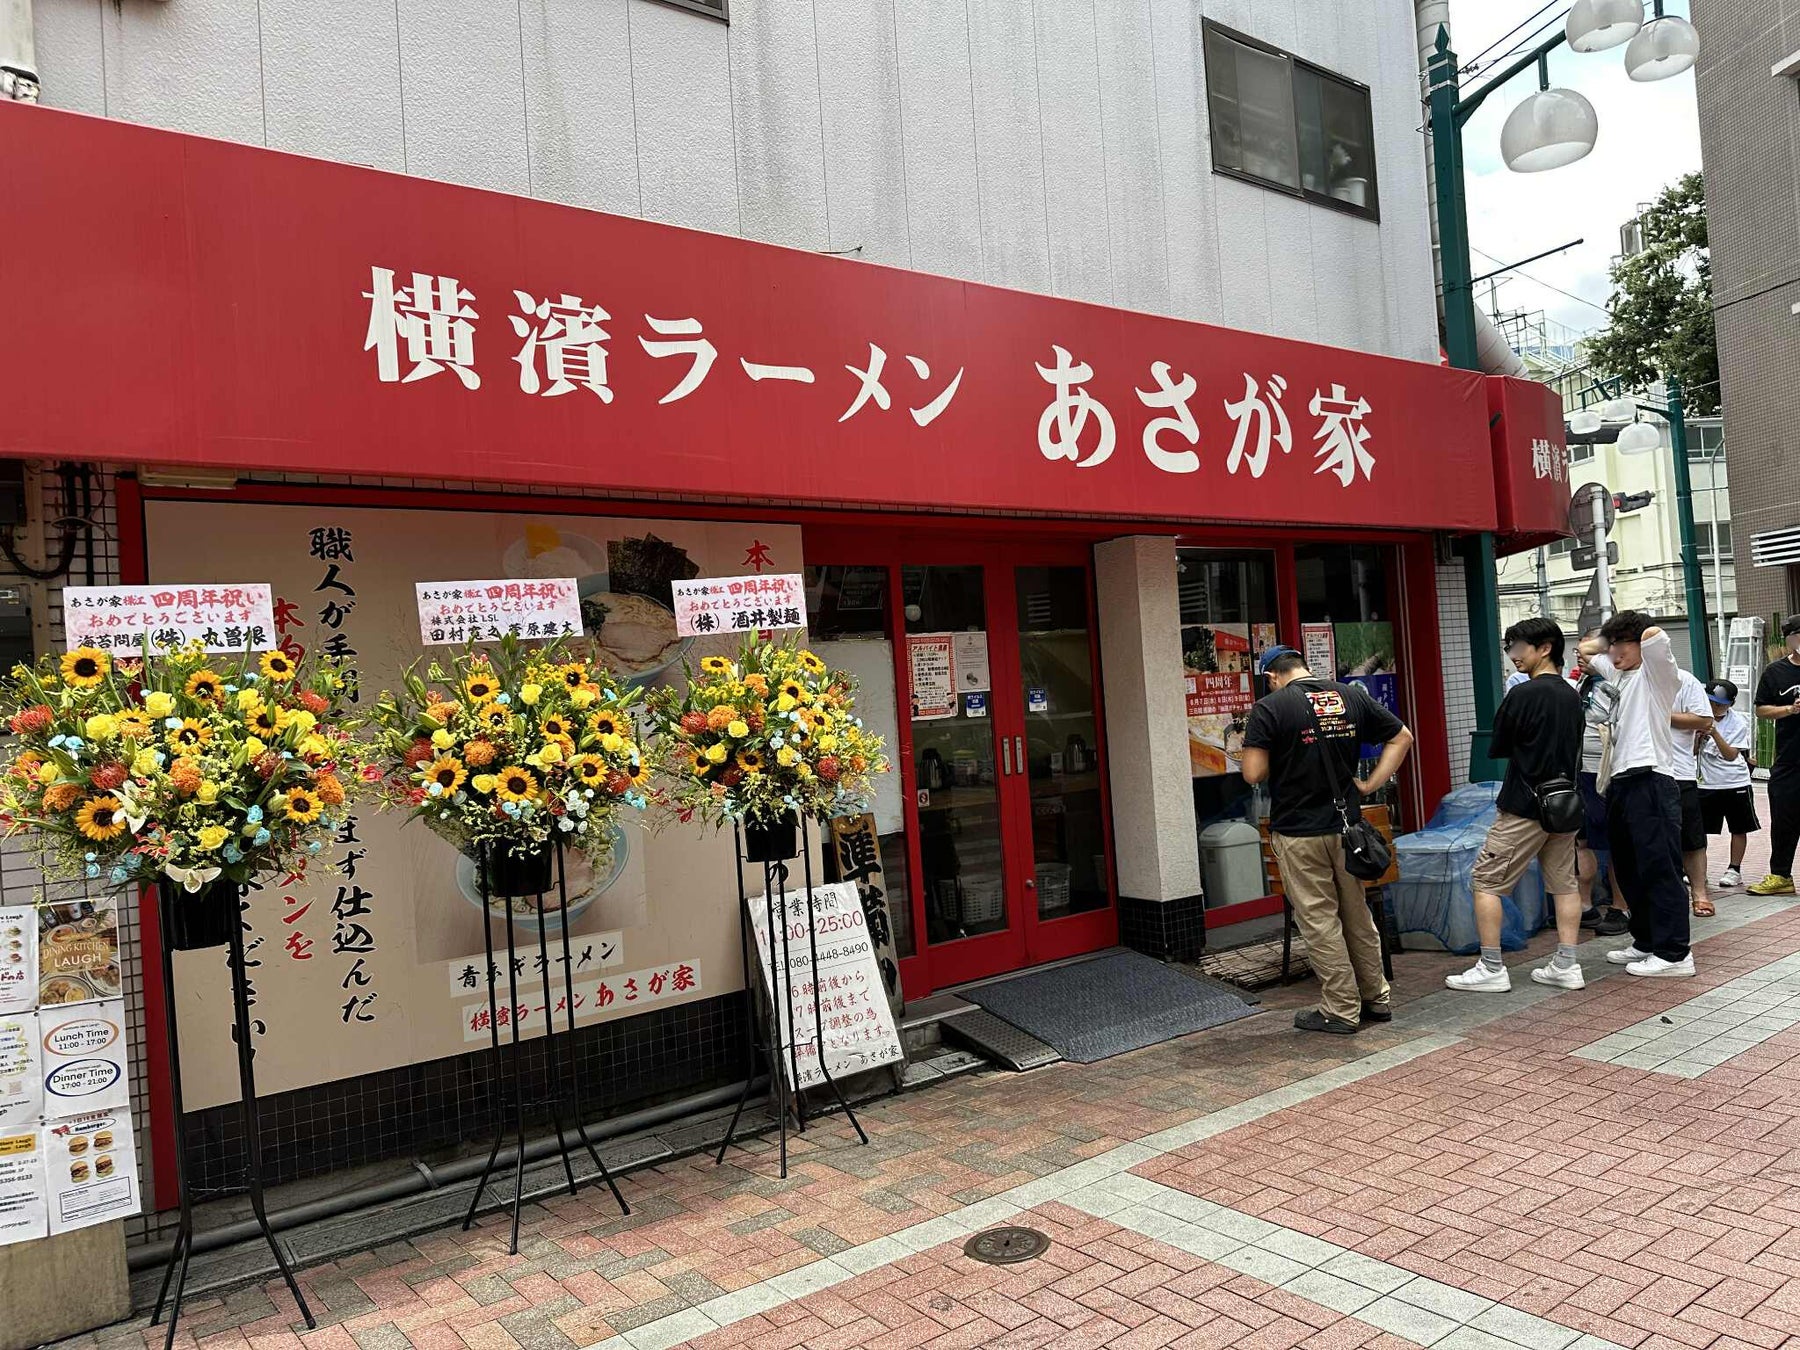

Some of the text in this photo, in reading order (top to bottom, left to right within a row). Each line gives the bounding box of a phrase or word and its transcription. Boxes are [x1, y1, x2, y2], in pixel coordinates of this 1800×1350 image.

[362, 265, 1377, 488] 横濱ラーメン あさが家
[484, 582, 571, 600] 四周年祝い
[726, 577, 798, 597] 四周年祝い
[150, 588, 263, 609] 四周年祝い
[54, 953, 102, 968] LAUGH
[594, 964, 696, 1008] あさが家
[54, 1029, 109, 1043] Lunch Time
[58, 1042, 80, 1050] 11:00
[53, 1072, 87, 1084] Dinner
[89, 1067, 114, 1077] Time
[61, 1081, 81, 1089] 17:00
